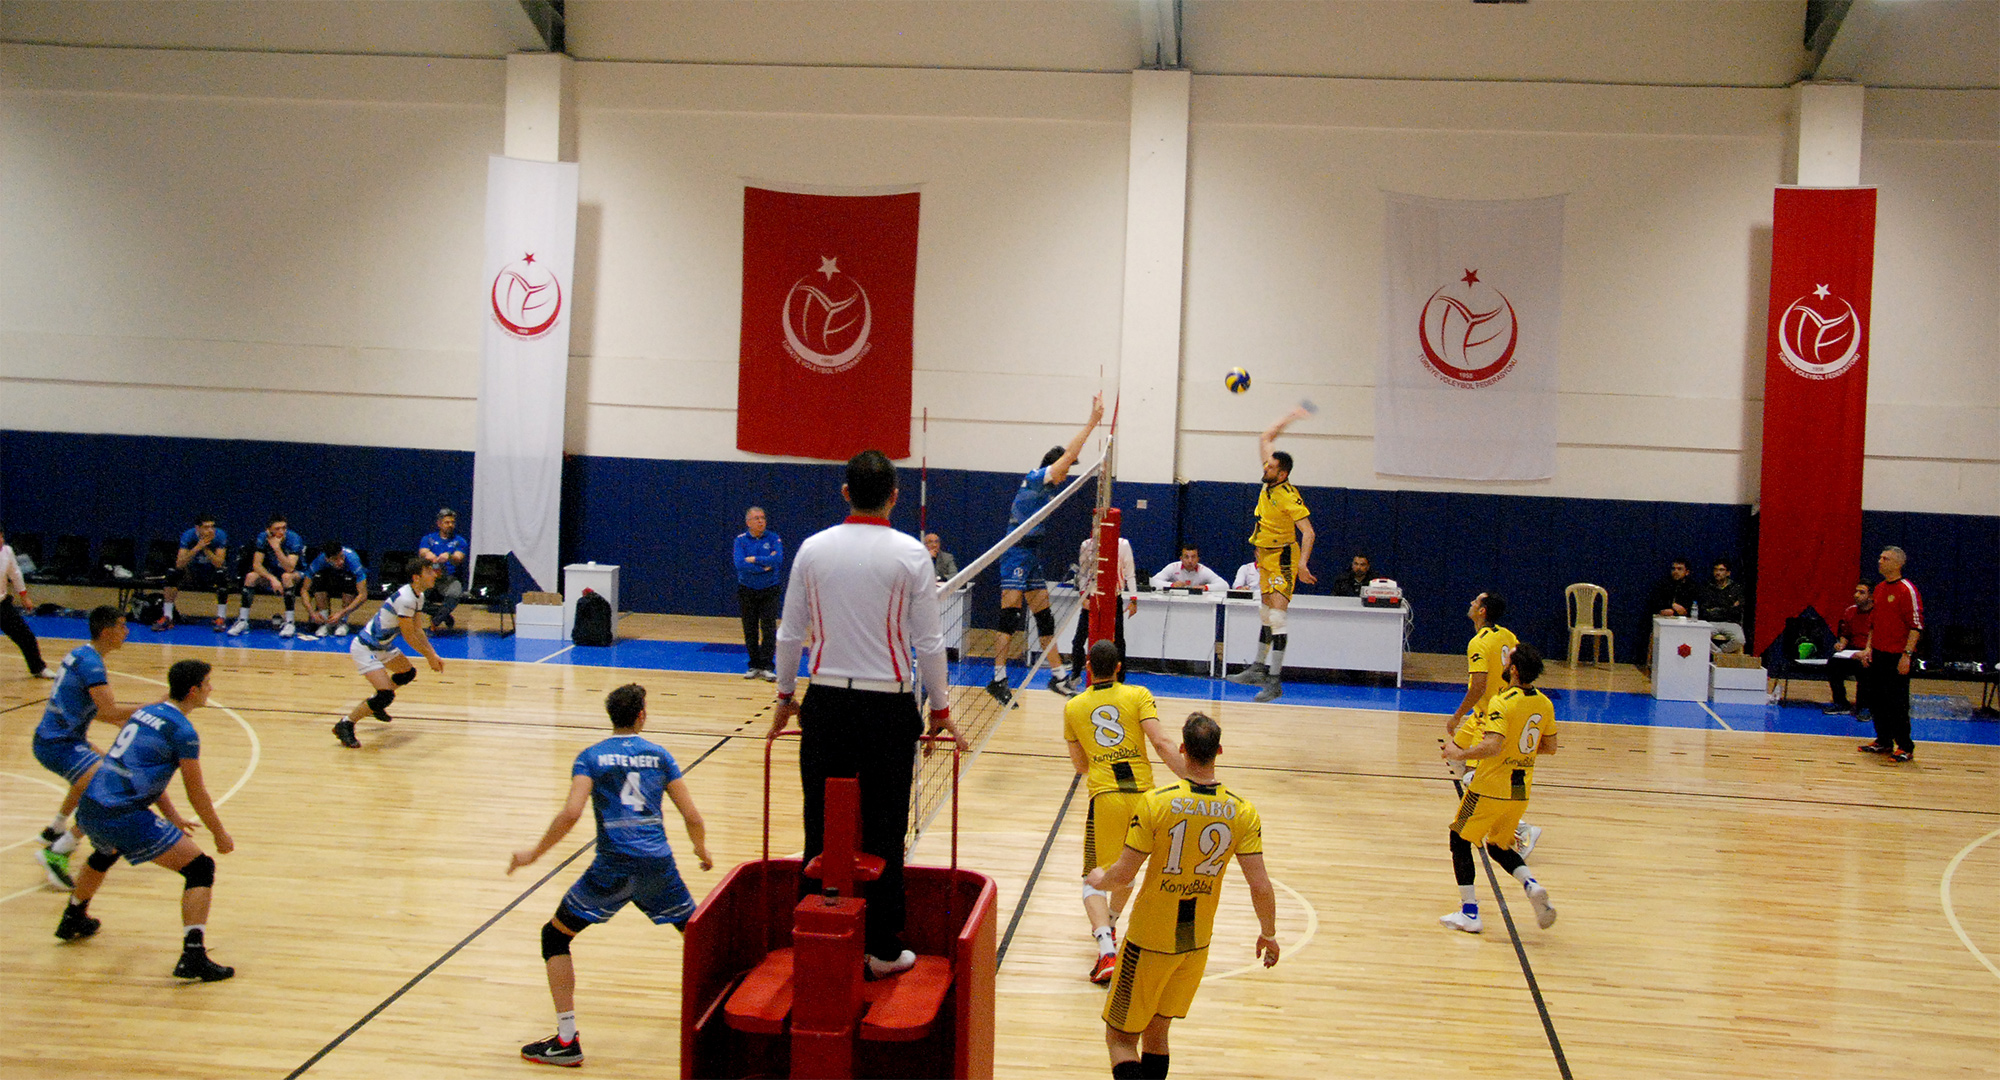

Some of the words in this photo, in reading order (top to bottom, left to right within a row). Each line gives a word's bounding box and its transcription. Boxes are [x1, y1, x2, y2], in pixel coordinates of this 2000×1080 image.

[1440, 375, 1475, 390] VOLEYBOL
[1475, 358, 1518, 388] FEDERASYONU
[109, 723, 139, 758] 9
[1090, 704, 1125, 747] 8
[1518, 713, 1543, 754] 6
[620, 772, 647, 811] 4
[1162, 819, 1232, 877] 12
